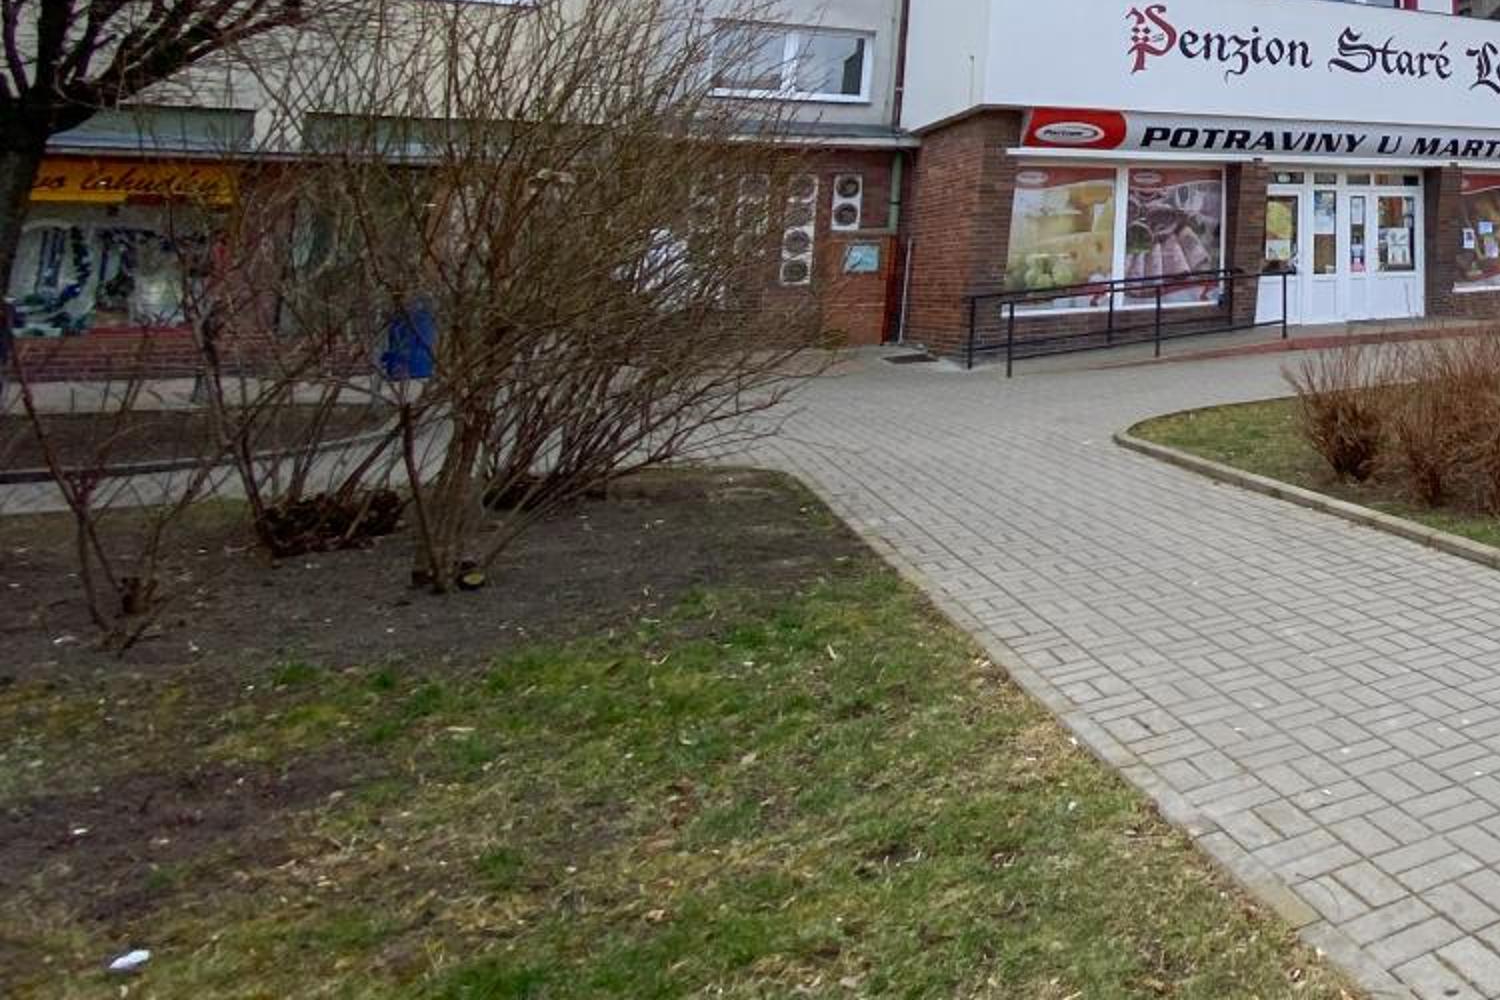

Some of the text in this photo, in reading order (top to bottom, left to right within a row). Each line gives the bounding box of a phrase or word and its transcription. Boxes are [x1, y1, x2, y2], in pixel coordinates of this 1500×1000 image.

[1125, 3, 1312, 83] Penzion
[1328, 26, 1452, 79] Staré
[1140, 126, 1366, 153] POTRAVINY
[1376, 136, 1400, 154] U
